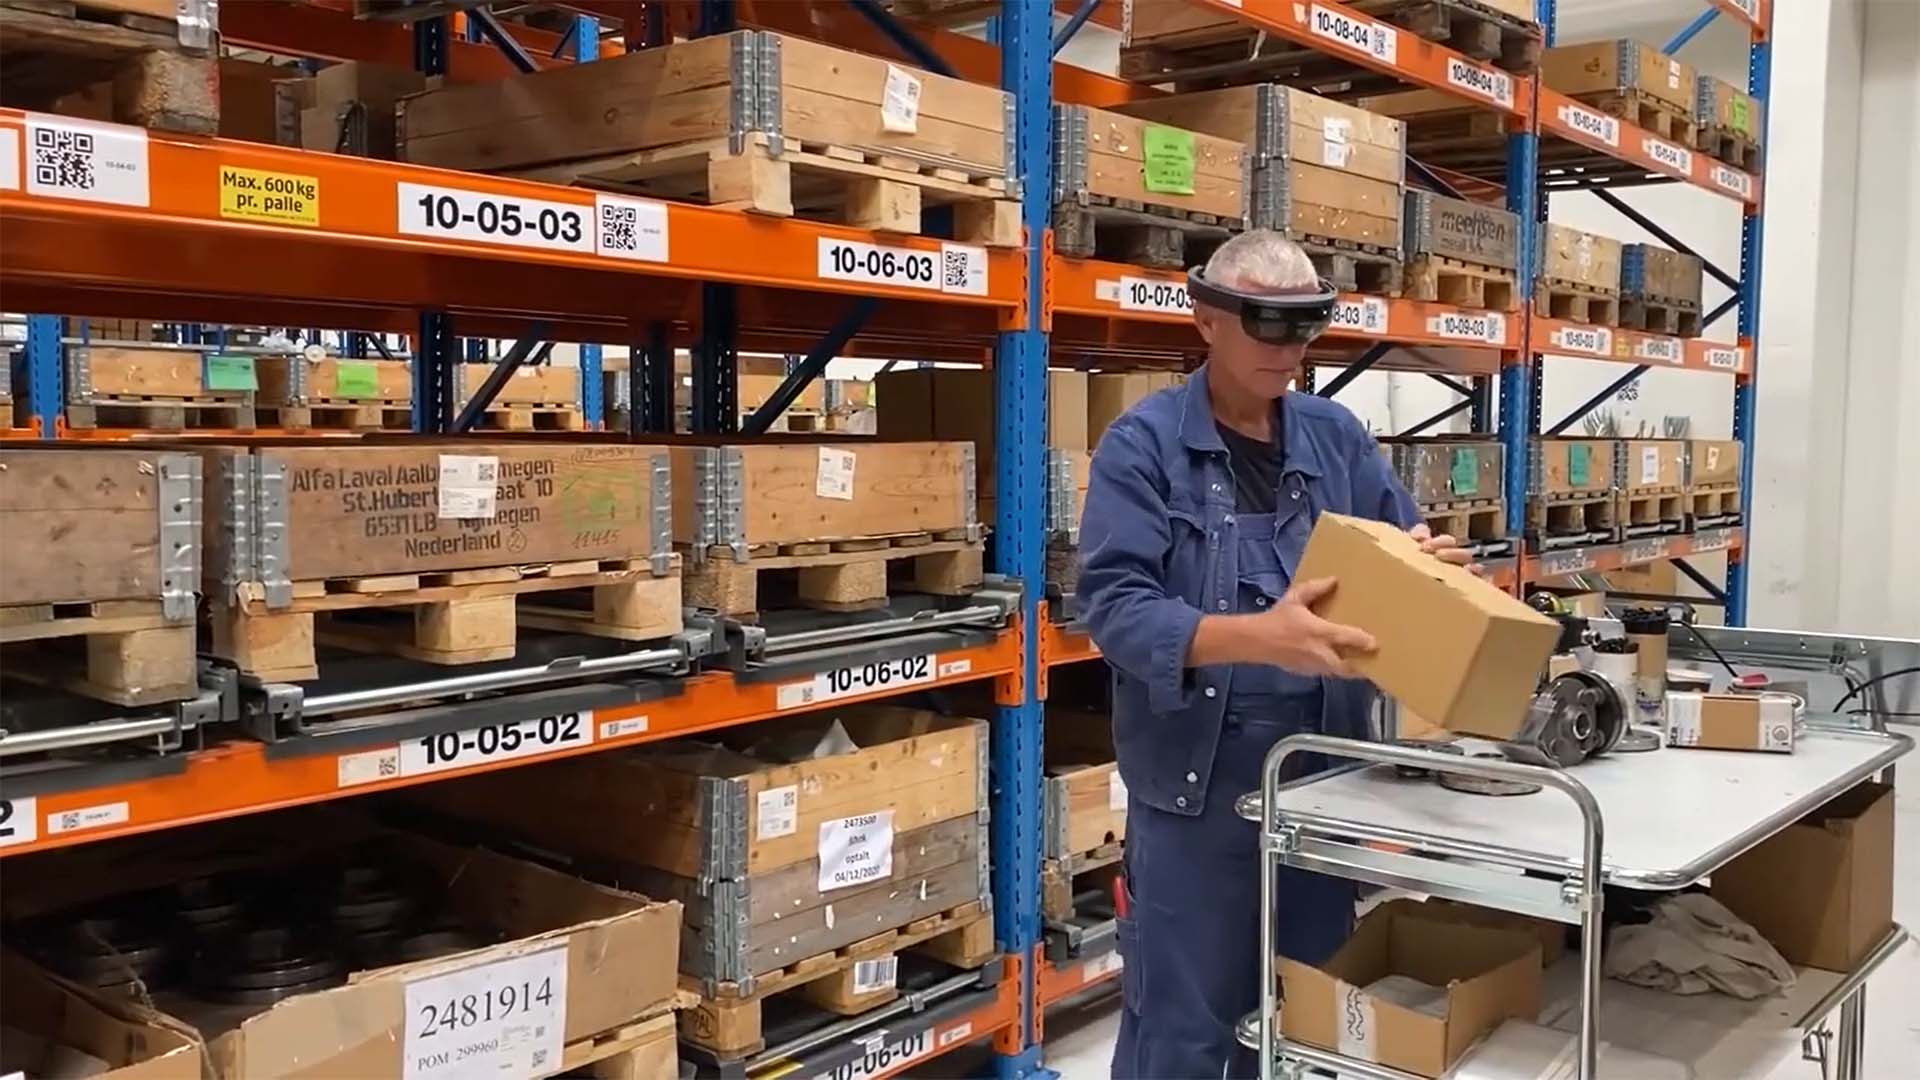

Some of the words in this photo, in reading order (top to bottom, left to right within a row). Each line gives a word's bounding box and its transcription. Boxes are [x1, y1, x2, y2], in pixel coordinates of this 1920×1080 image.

[1317, 11, 1368, 47] 10-08-04
[1453, 63, 1492, 92] 10-09-04
[223, 171, 262, 190] Max.
[264, 177, 295, 194] 600
[296, 180, 316, 200] kg
[236, 193, 258, 209] pr.
[264, 196, 303, 213] palle
[418, 193, 583, 244] 10-05-03
[830, 245, 933, 282] 10-06-03
[1444, 317, 1485, 337] 10-09-03
[292, 468, 336, 493] Alfa
[339, 464, 393, 489] Laval
[534, 478, 553, 498] 10
[404, 530, 501, 559] Nederland
[826, 655, 928, 694] 10-06-02
[420, 712, 580, 765] 10-05-02
[418, 975, 553, 1039] 2481914
[417, 1051, 450, 1071] POM
